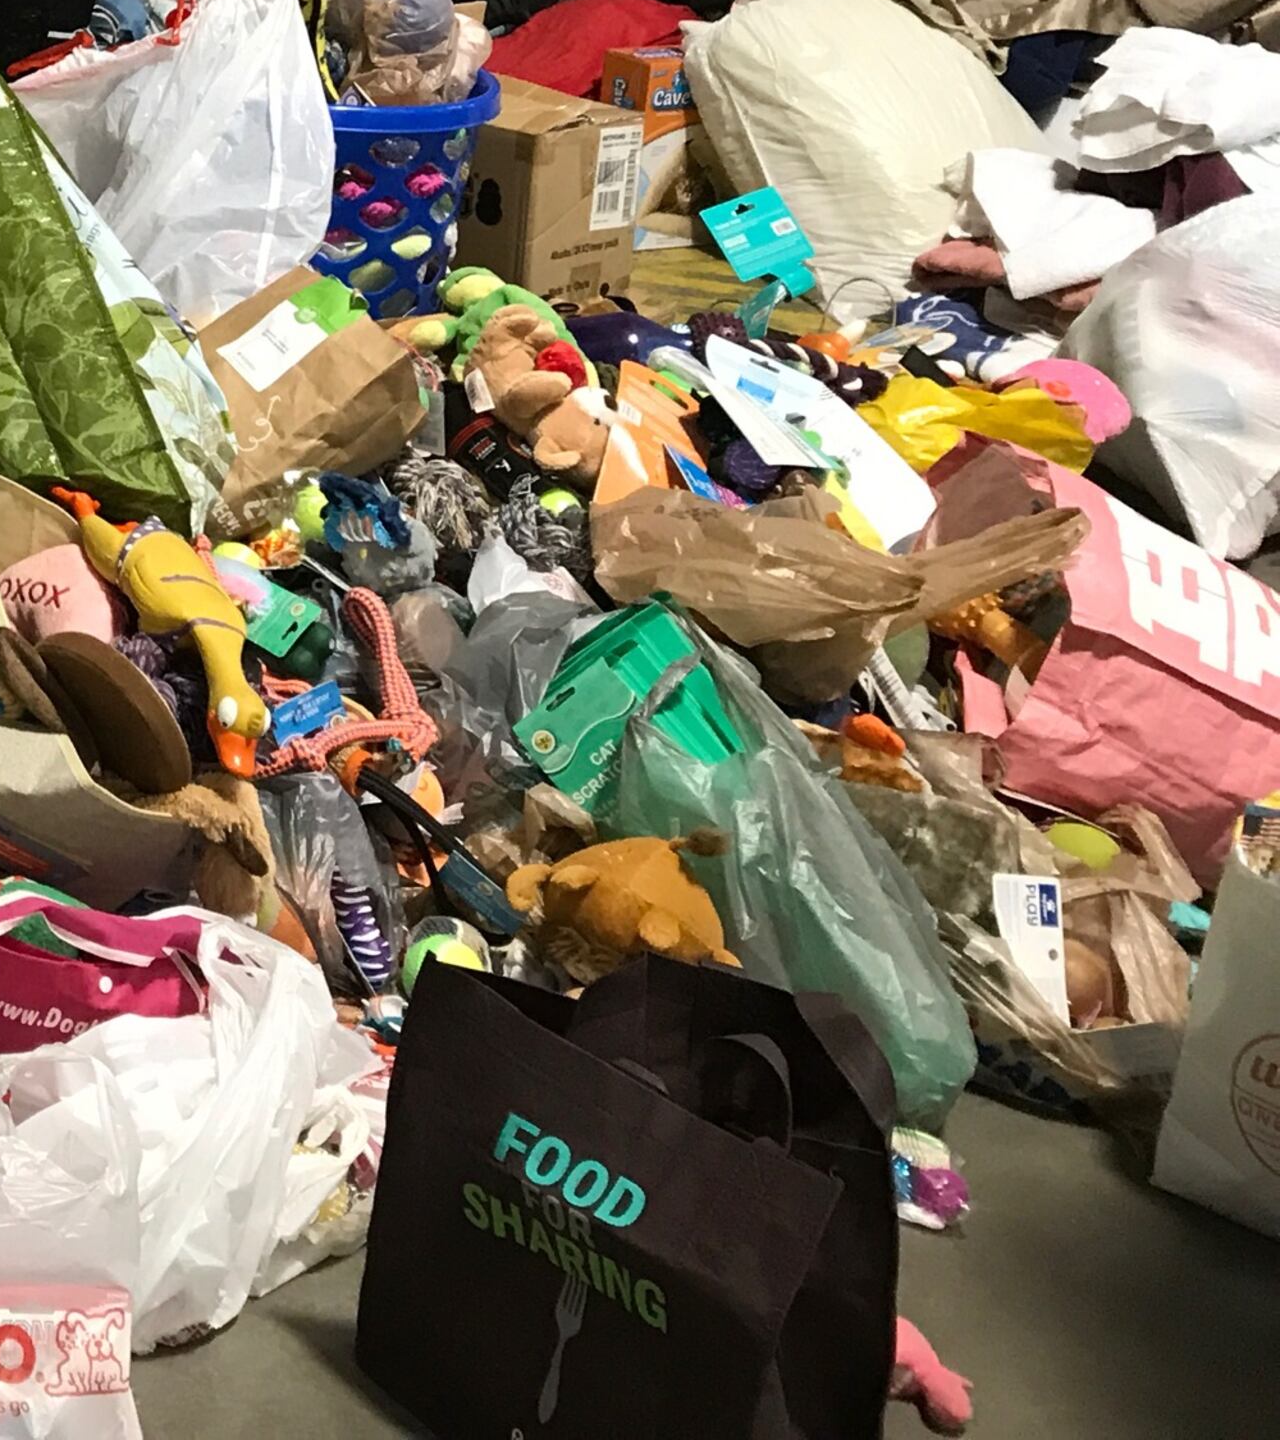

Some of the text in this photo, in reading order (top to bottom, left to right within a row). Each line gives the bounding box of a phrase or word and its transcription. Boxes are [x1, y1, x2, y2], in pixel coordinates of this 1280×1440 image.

[589, 738, 618, 767] CAT
[571, 759, 622, 806] SCRATC
[493, 1111, 647, 1228] FOOD
[521, 1180, 596, 1249] FOR
[462, 1182, 668, 1334] SHARING
[9, 1400, 31, 1419] go
